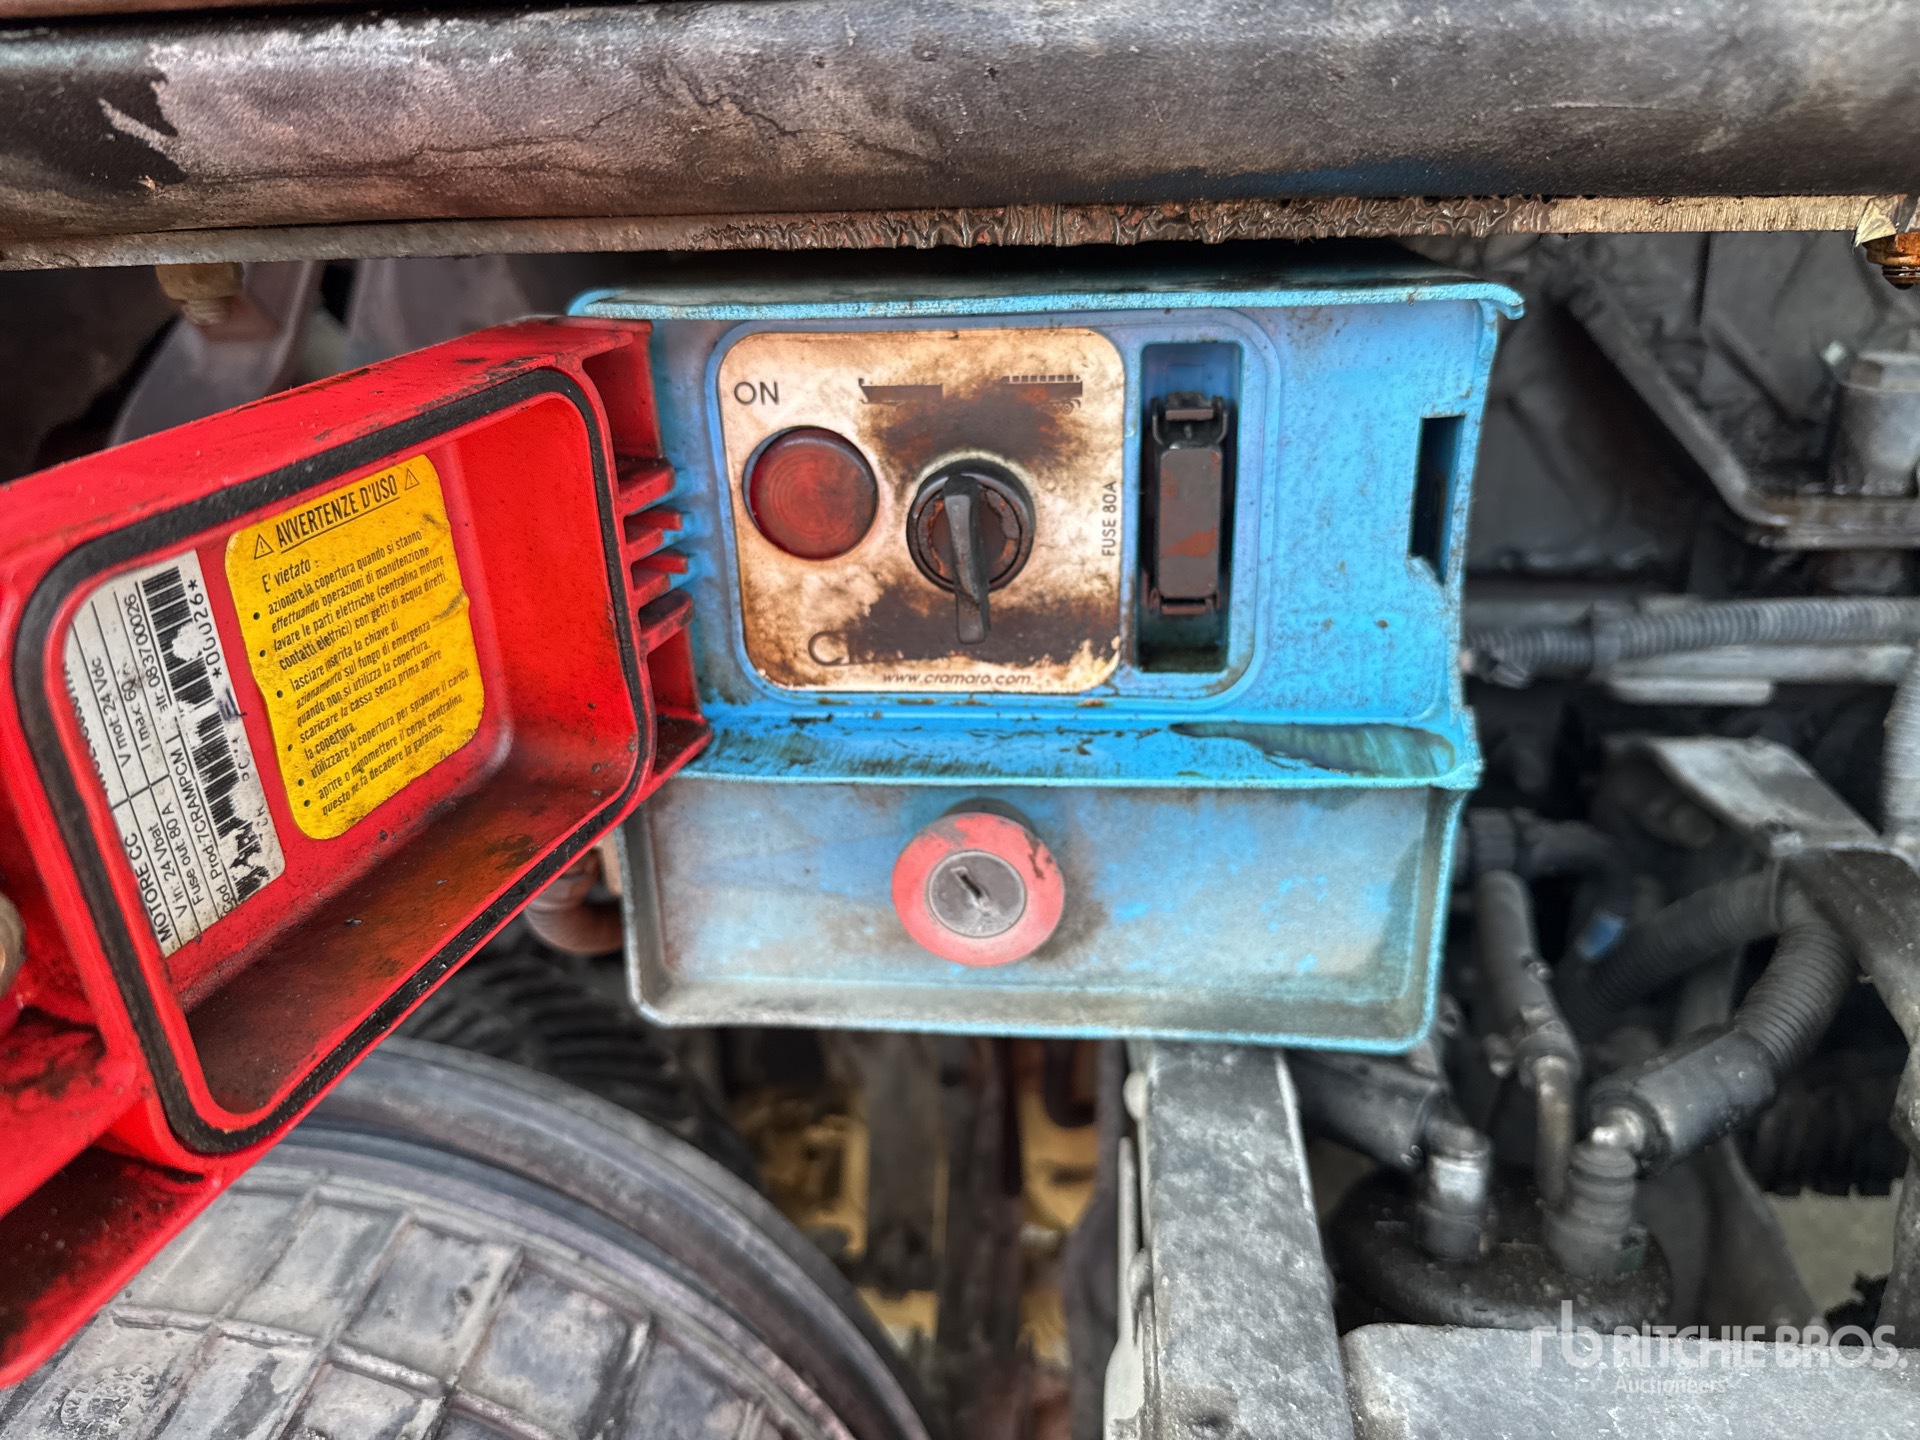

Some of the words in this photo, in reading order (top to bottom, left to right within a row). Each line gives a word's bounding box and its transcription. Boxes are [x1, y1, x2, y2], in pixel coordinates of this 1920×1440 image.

[734, 381, 780, 406] ON
[275, 491, 358, 547] AVVERTENZE
[359, 474, 397, 509] D'USO
[1102, 480, 1117, 514] 80A
[1101, 520, 1117, 557] FUSE
[261, 572, 271, 593] E'
[273, 558, 311, 586] vietato
[268, 588, 304, 615] azionare
[314, 562, 355, 590] copertura
[356, 546, 385, 571] quando
[386, 540, 394, 554] si
[395, 530, 422, 550] stanno
[271, 598, 319, 633] effettuando
[321, 574, 364, 607] operazioni
[365, 569, 374, 584] di
[375, 546, 429, 579] manutenzione
[273, 630, 300, 652] lavare
[301, 623, 311, 637] le
[312, 609, 334, 634] parti
[335, 591, 375, 619] elettriche
[376, 569, 418, 599] (centralina
[418, 555, 444, 575] motore
[278, 640, 317, 670] contatti
[315, 619, 352, 650] elettrici)
[354, 613, 369, 629] con
[370, 602, 389, 623] getti
[391, 596, 399, 609] di
[400, 585, 422, 604] acqua
[423, 571, 446, 592] diretti.
[123, 593, 160, 687] 083700026
[289, 664, 324, 691] lasciare
[353, 639, 362, 652] la
[364, 625, 389, 646] chiave
[390, 618, 398, 631] di
[91, 657, 107, 692] Vdc
[296, 671, 342, 710] azionamento
[343, 659, 357, 677] sul
[357, 649, 380, 669] fungo
[381, 640, 390, 655] di
[391, 620, 430, 650] emergenza
[297, 701, 325, 727] quando
[325, 691, 342, 707] non
[343, 682, 351, 697] si
[352, 667, 382, 691] utilizza
[382, 661, 391, 673] la
[392, 640, 430, 668] copertura.
[99, 692, 116, 715] 24
[299, 712, 338, 743] scaricare
[340, 706, 348, 718] la
[349, 691, 373, 712] cassa
[374, 677, 396, 697] senza
[397, 663, 419, 685] prima
[420, 649, 441, 669] aprire
[108, 714, 127, 749] mot:
[130, 703, 149, 741] max:
[310, 747, 349, 778] utilizzare
[349, 740, 357, 752] la
[356, 715, 395, 746] copertura
[395, 706, 408, 723] per
[409, 686, 440, 712] spianare
[440, 679, 446, 692] il
[117, 753, 131, 767] V
[303, 748, 314, 761] la
[318, 776, 343, 799] aprire
[344, 771, 350, 781] o
[398, 728, 404, 741] il
[405, 717, 427, 737] corpo
[321, 790, 350, 816] questo
[359, 775, 368, 787] fa
[368, 751, 403, 780] decadere
[403, 744, 412, 756] la
[161, 801, 174, 815] A
[123, 832, 142, 860] CC
[147, 822, 167, 861] Vbat
[165, 818, 181, 839] 80
[160, 860, 176, 881] 24
[174, 838, 190, 866] out:
[134, 861, 172, 943] MOTORE
[170, 881, 183, 903] in:
[186, 867, 204, 905] Fuse
[216, 879, 235, 914] Cod.
[174, 904, 187, 918] V
